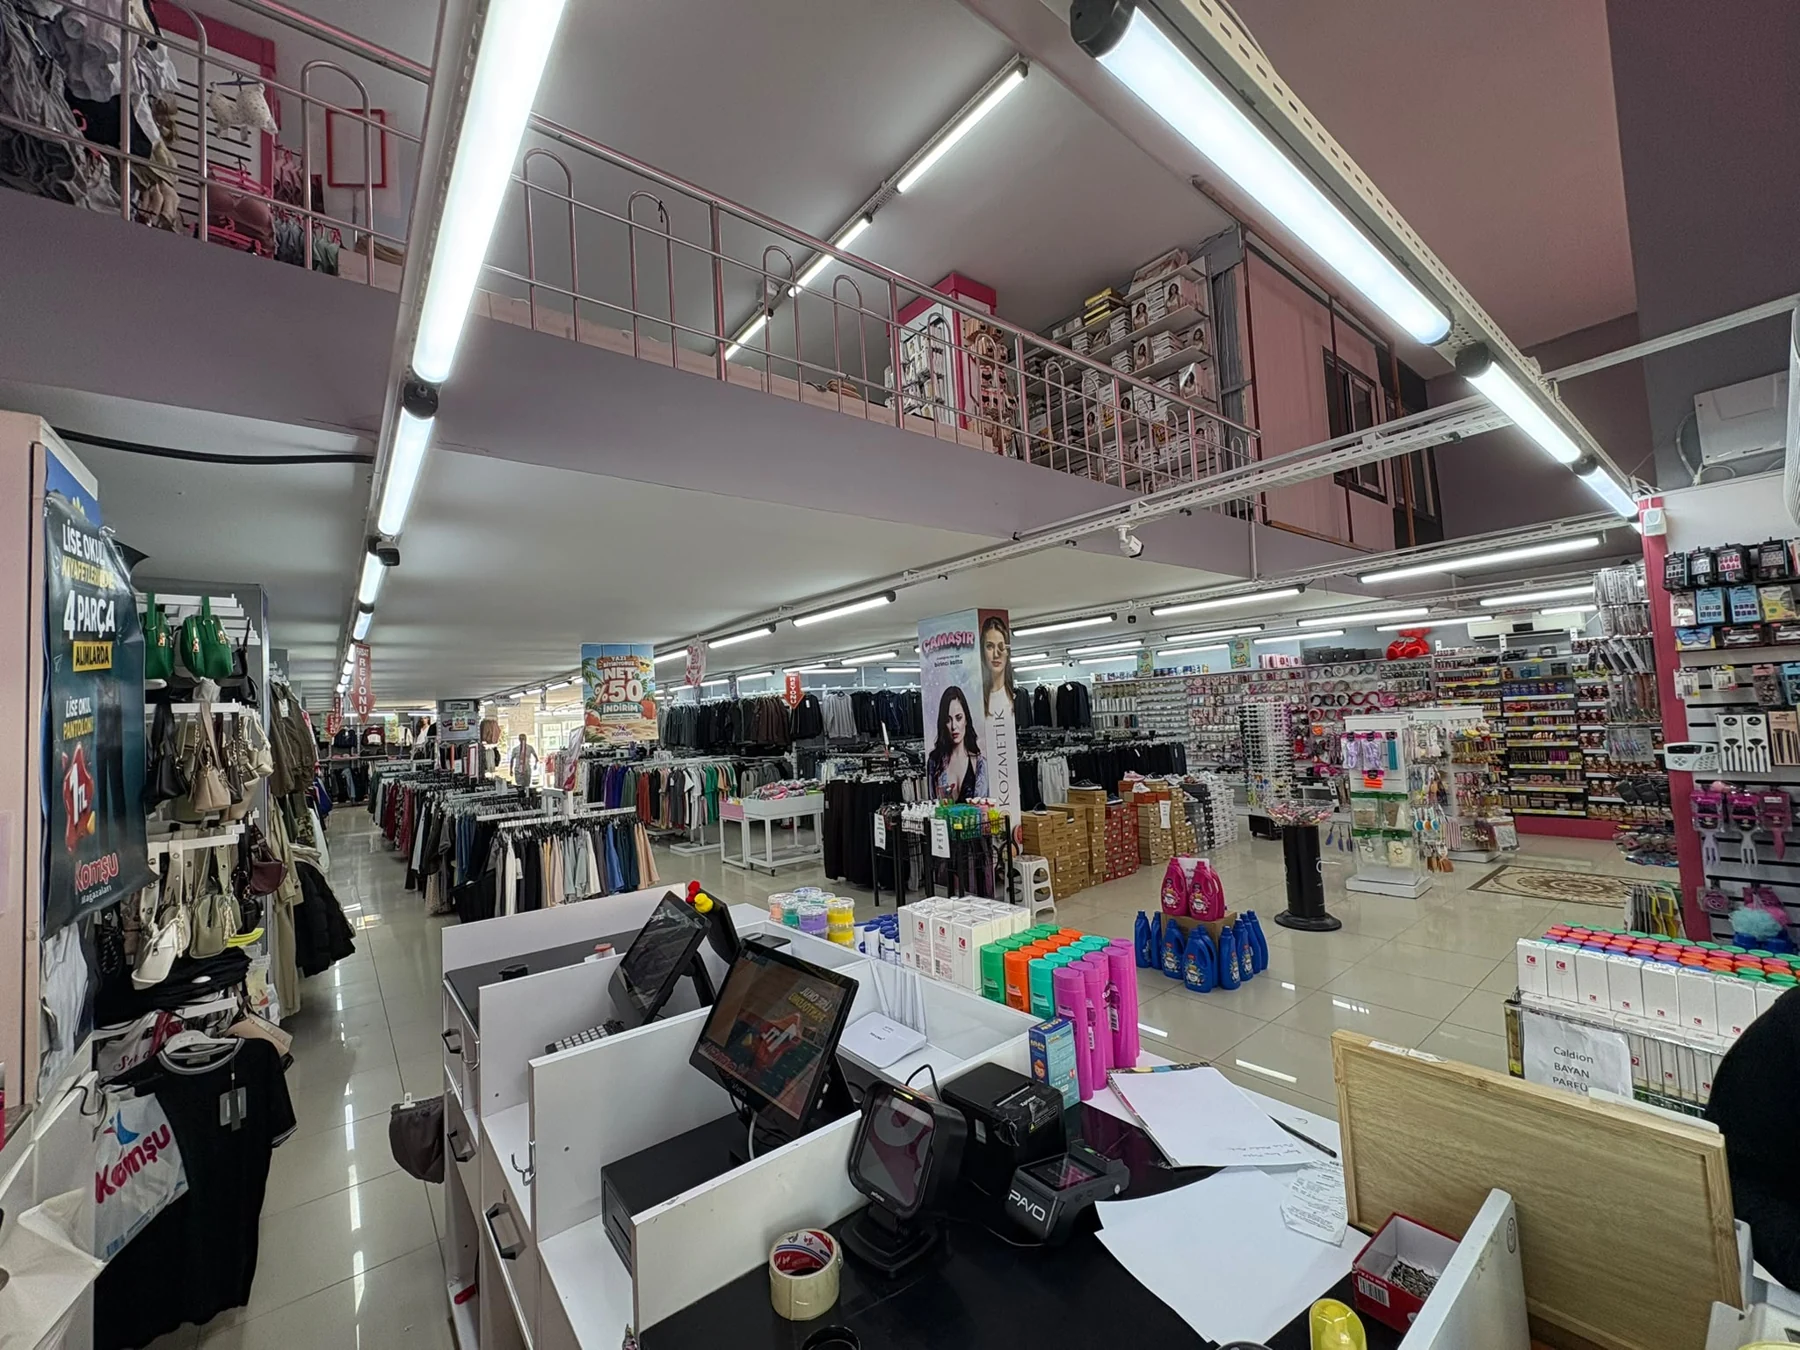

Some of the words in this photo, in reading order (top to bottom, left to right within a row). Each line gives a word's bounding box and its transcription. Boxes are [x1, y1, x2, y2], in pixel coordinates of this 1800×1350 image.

[62, 519, 83, 557] LİSE
[63, 589, 76, 640] 4
[77, 595, 116, 638] PARÇA
[923, 631, 975, 653] ÇAMAŞIR
[358, 658, 367, 714] REYONU
[604, 667, 634, 680] NET
[594, 680, 643, 703] %50
[603, 703, 638, 714] İNDİRİM
[993, 708, 1010, 807] KOZMETİK
[69, 763, 79, 825] 1
[74, 852, 119, 895] Komşu
[1553, 1046, 1594, 1064] Caldion
[1554, 1062, 1590, 1078] BAYAN
[1552, 1076, 1591, 1093] PARFÜ
[95, 1123, 172, 1204] Komşu
[1008, 1189, 1046, 1222] PAVO
